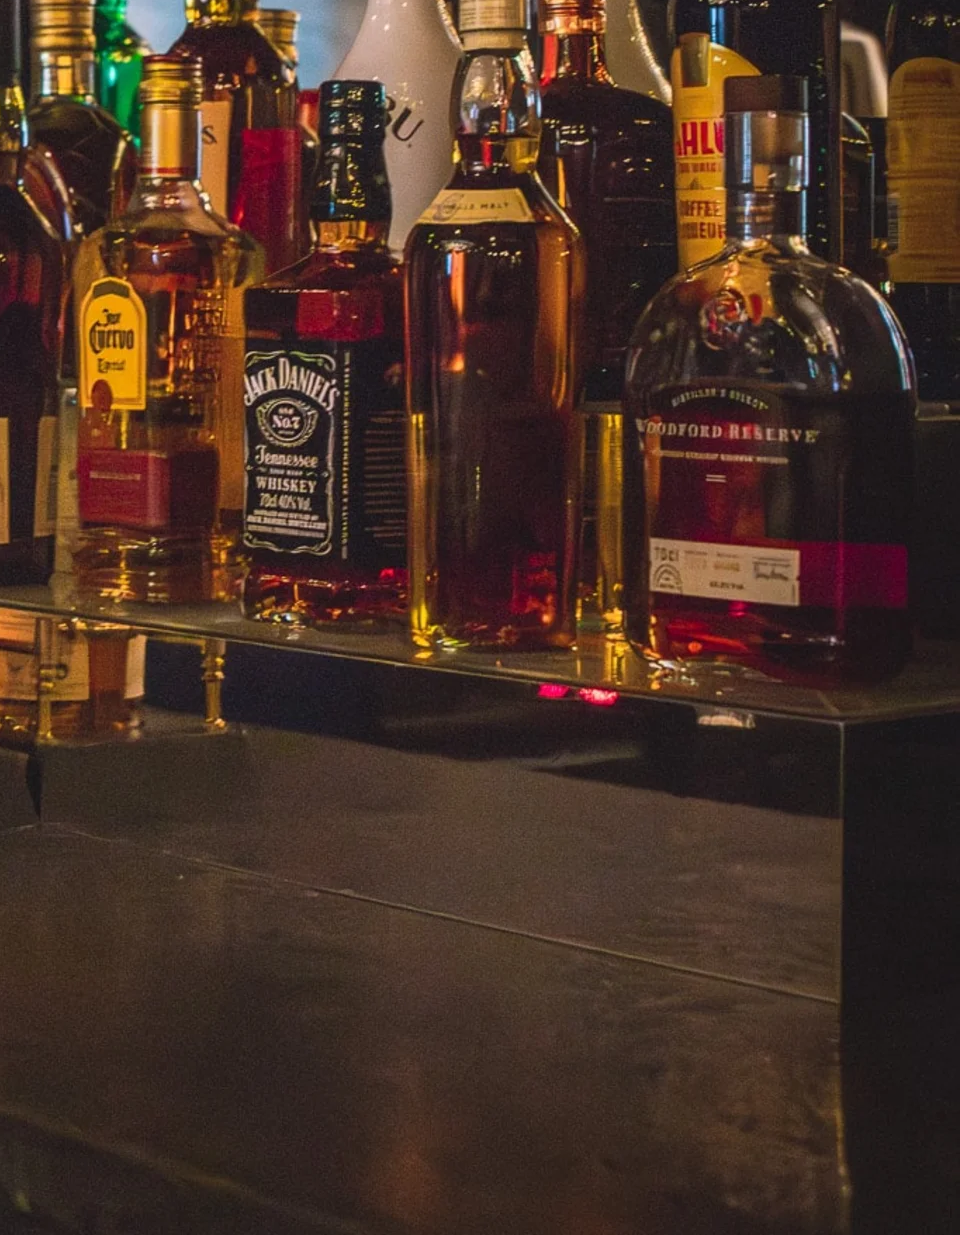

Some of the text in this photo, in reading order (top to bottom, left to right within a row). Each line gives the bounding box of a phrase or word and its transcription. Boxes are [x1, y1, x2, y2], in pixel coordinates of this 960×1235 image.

[243, 357, 340, 412] JACK DANIEL'S
[635, 418, 821, 444] WOODFORD RESERVE
[255, 444, 318, 468] Tennessee
[255, 476, 318, 494] WHISKEY
